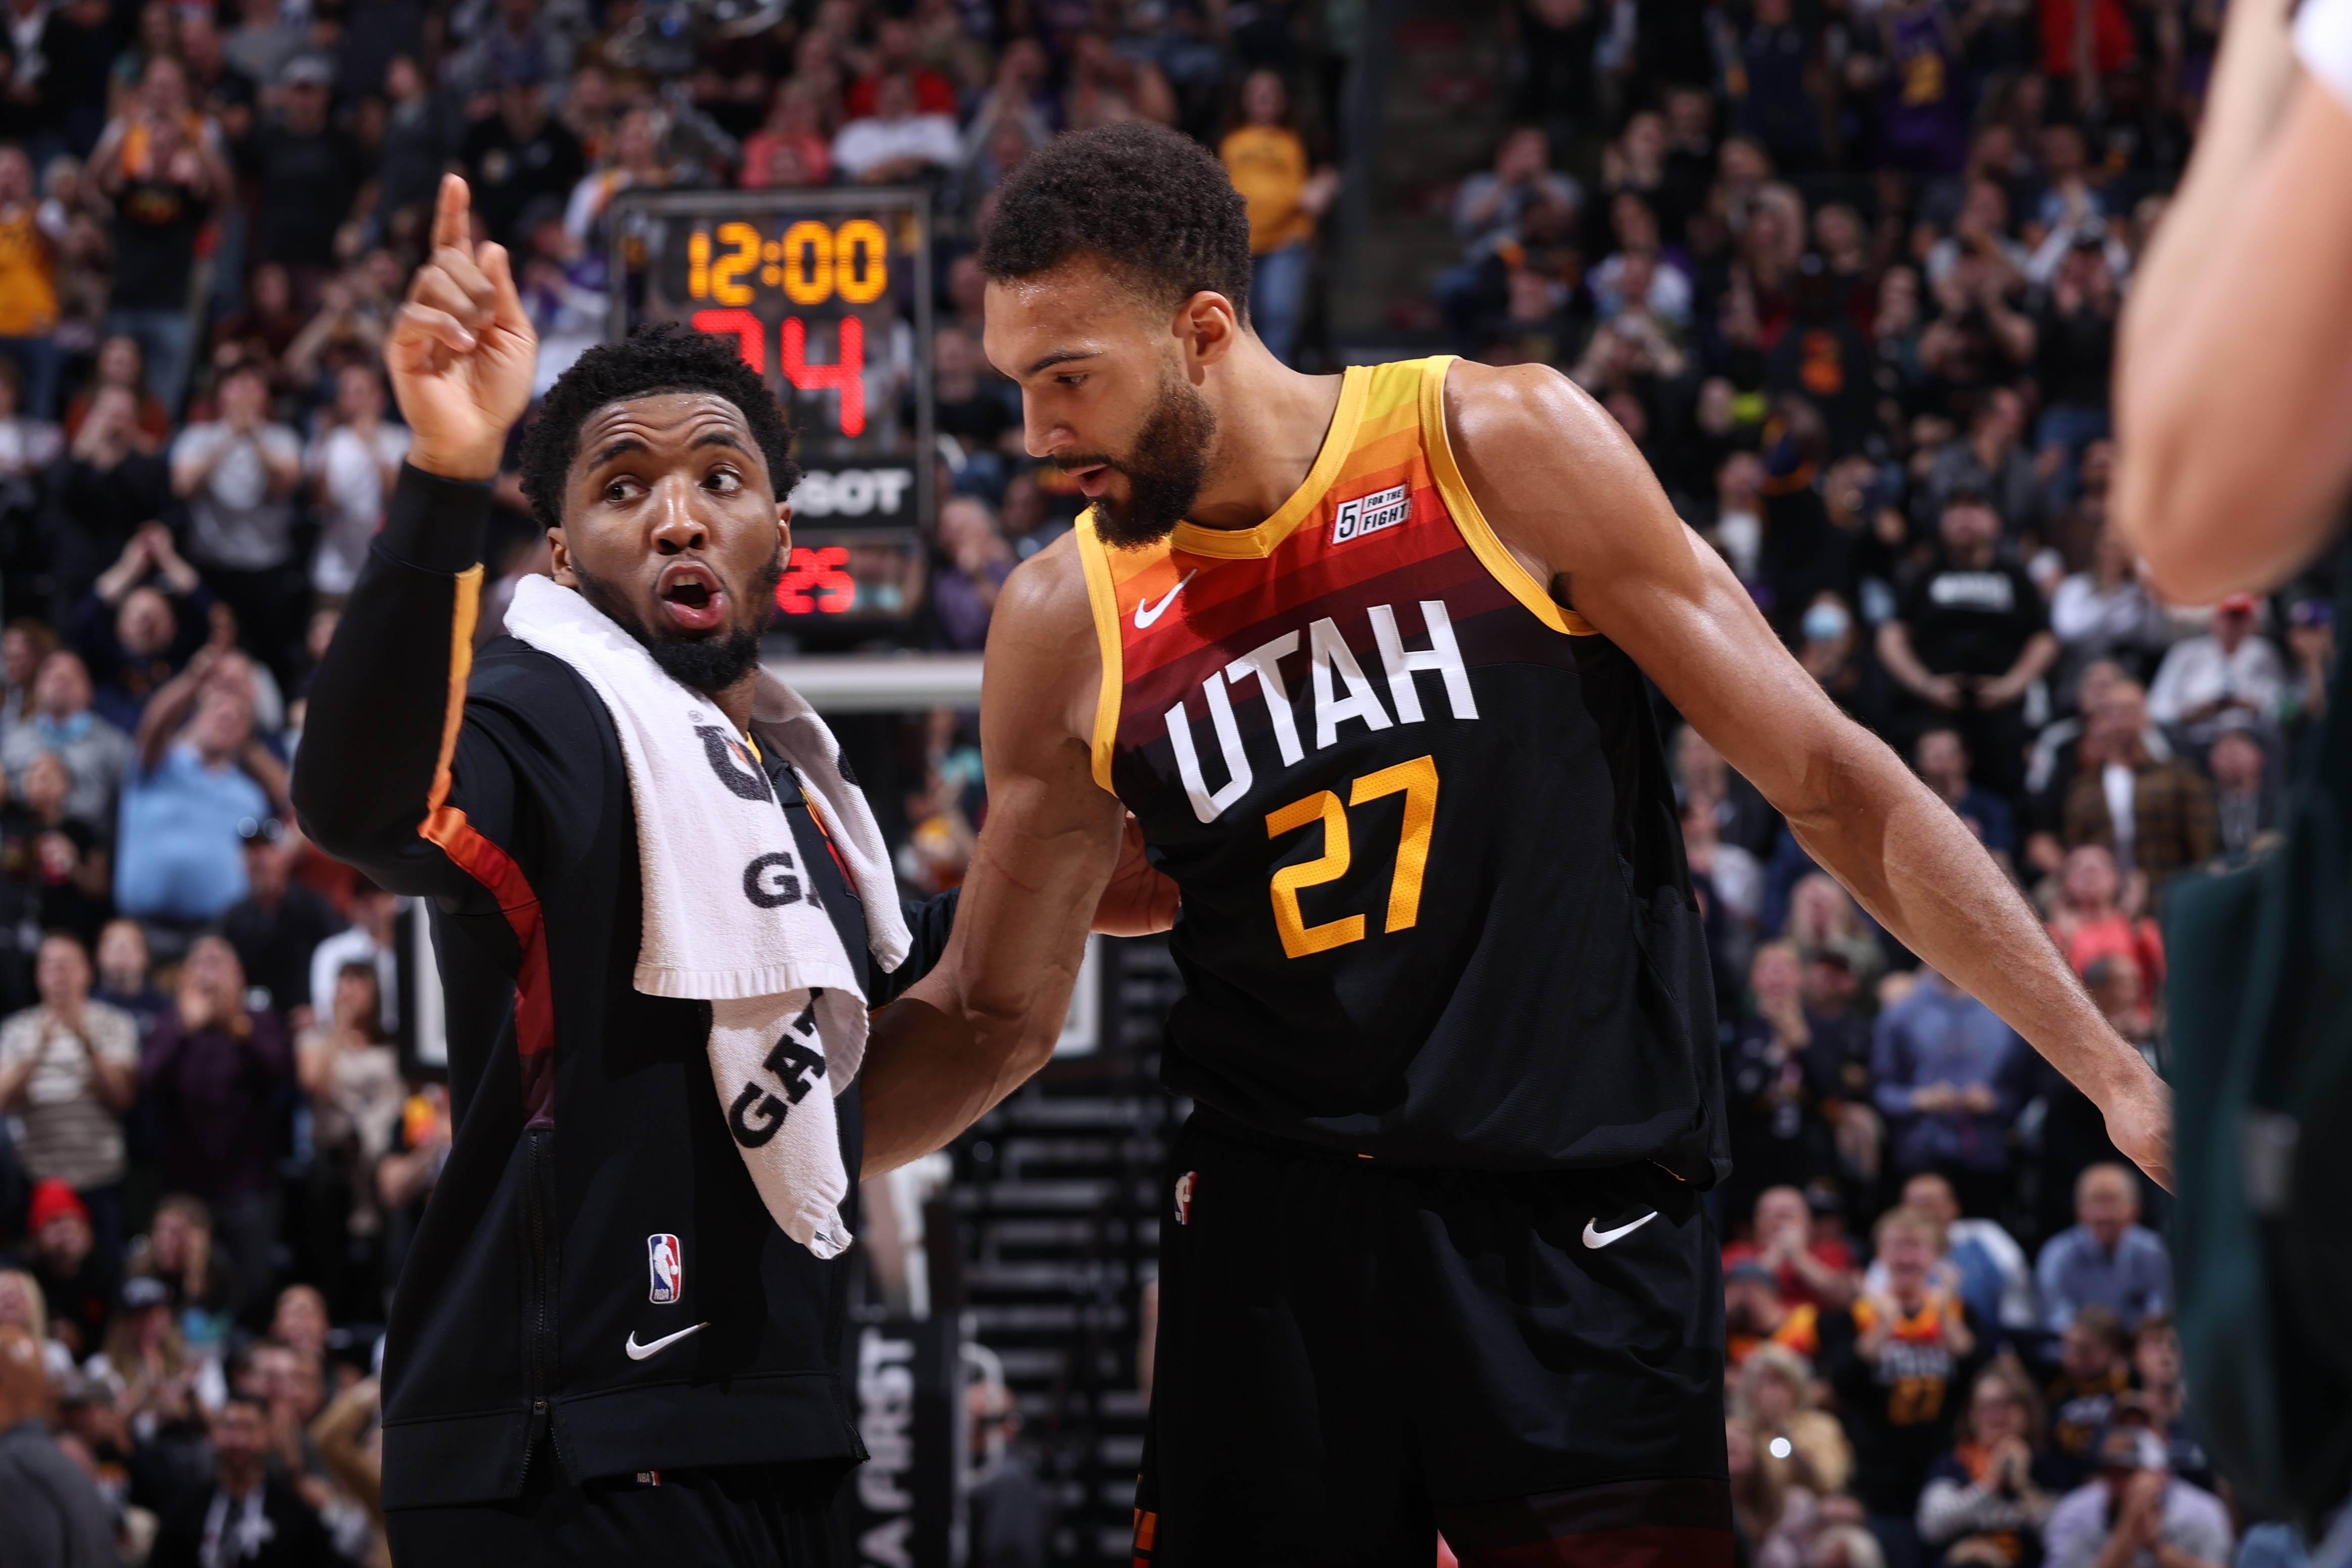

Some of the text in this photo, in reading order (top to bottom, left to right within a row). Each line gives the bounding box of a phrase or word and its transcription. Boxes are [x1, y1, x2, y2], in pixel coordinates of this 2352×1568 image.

[688, 219, 888, 306] 12:00
[1339, 504, 1357, 538] 5
[1363, 503, 1407, 530] FIGHT
[1367, 489, 1402, 507] FOR THE
[776, 547, 856, 614] 25
[1165, 600, 1479, 823] UTAH
[1265, 755, 1439, 958] 27
[856, 1326, 917, 1512] FIRST
[637, 1473, 650, 1483] NBA
